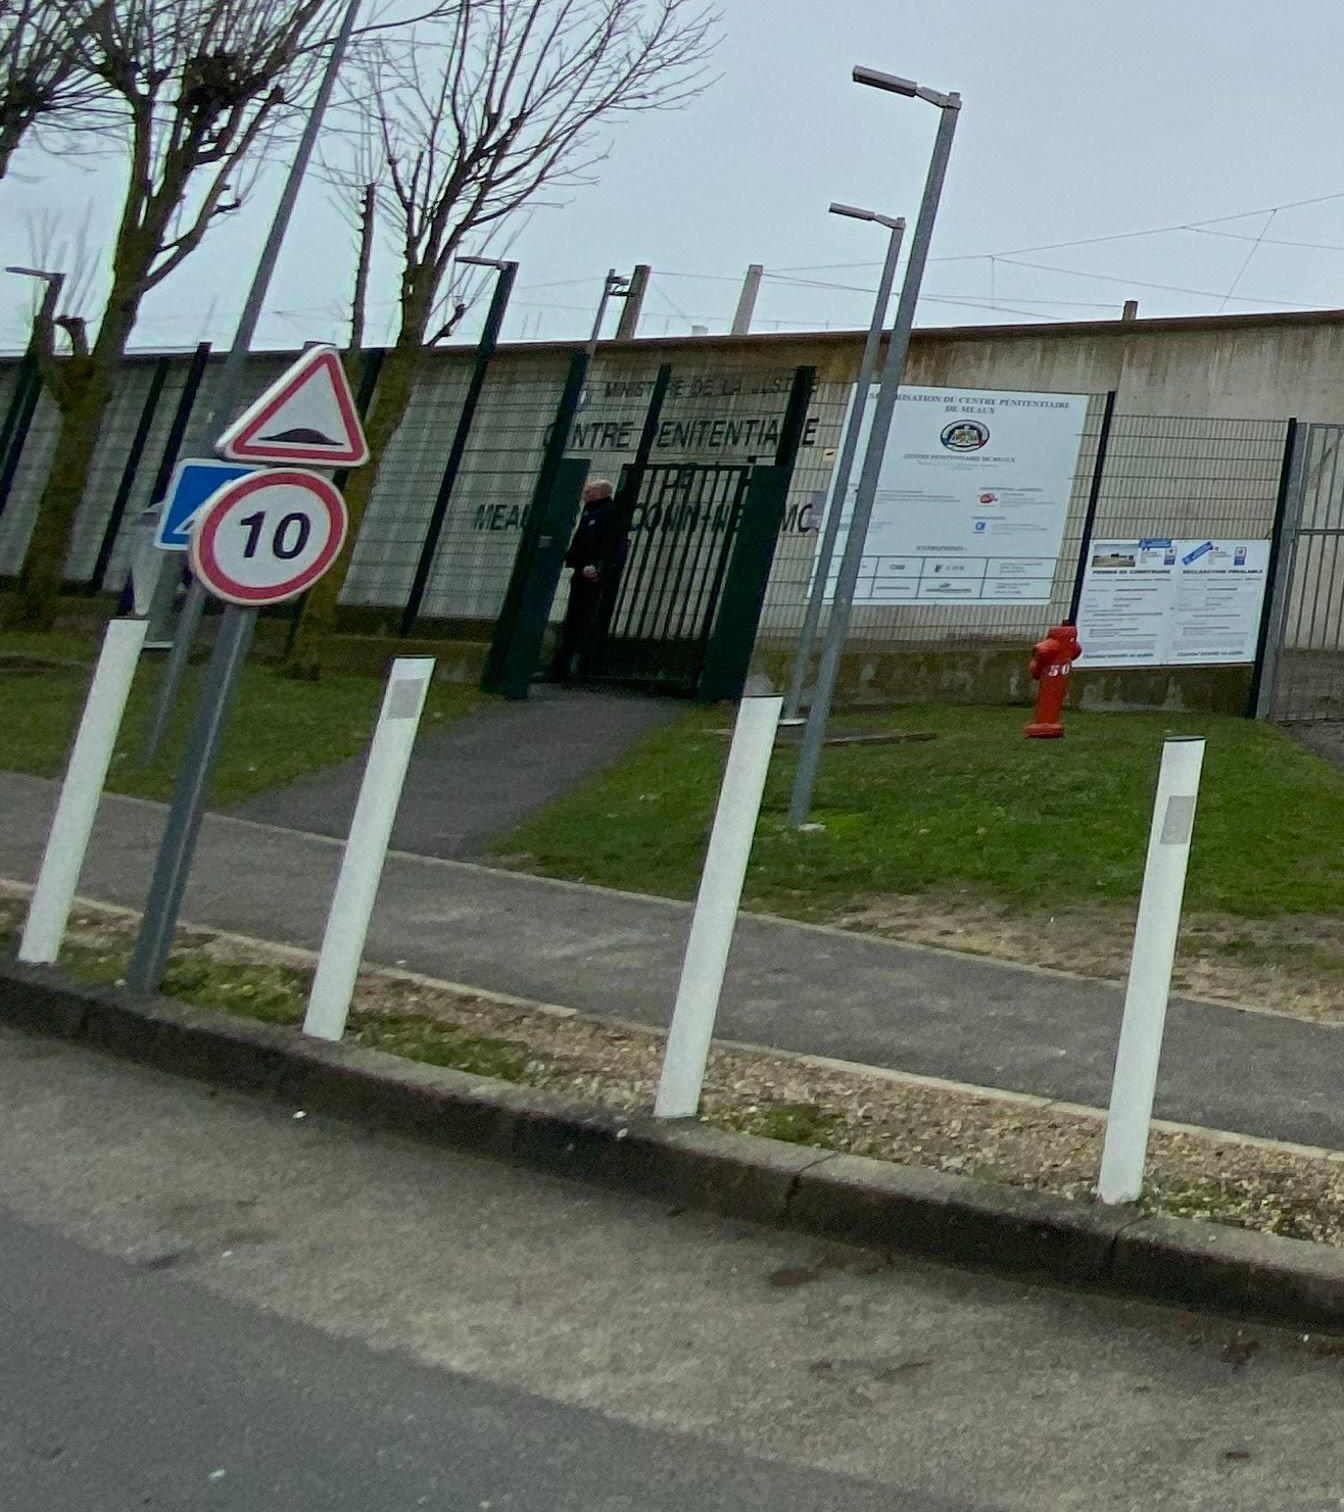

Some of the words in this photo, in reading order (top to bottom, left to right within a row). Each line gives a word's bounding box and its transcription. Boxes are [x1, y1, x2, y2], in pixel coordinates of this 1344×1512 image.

[958, 396, 996, 405] CENTRE
[960, 405, 995, 414] MEAUX
[544, 422, 634, 449] CNTRE
[240, 510, 311, 559] 10
[1047, 663, 1071, 678] 50
